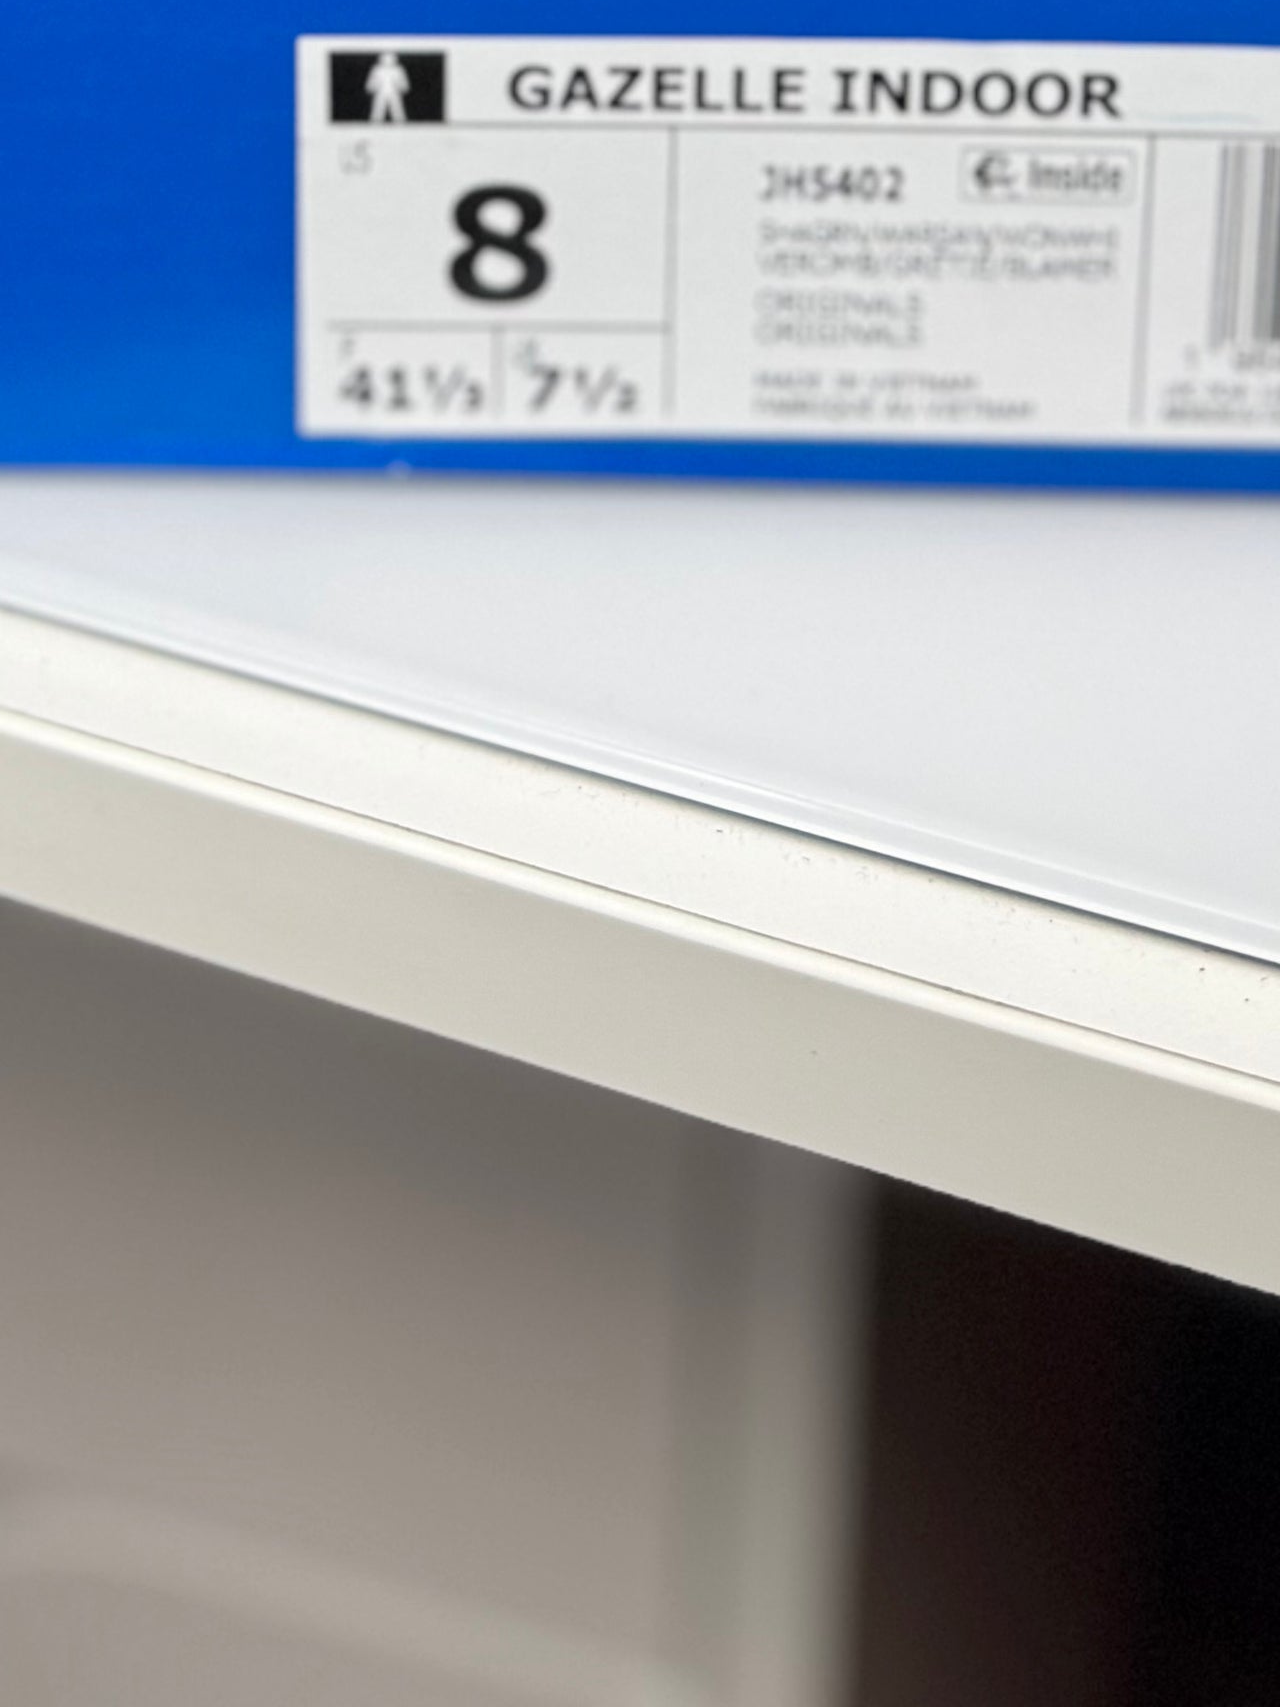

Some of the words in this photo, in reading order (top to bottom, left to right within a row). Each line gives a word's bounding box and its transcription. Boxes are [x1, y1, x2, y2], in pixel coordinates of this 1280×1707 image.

[508, 65, 806, 113] GAZELLE
[831, 68, 1123, 118] INDOOR
[449, 183, 549, 303] 8
